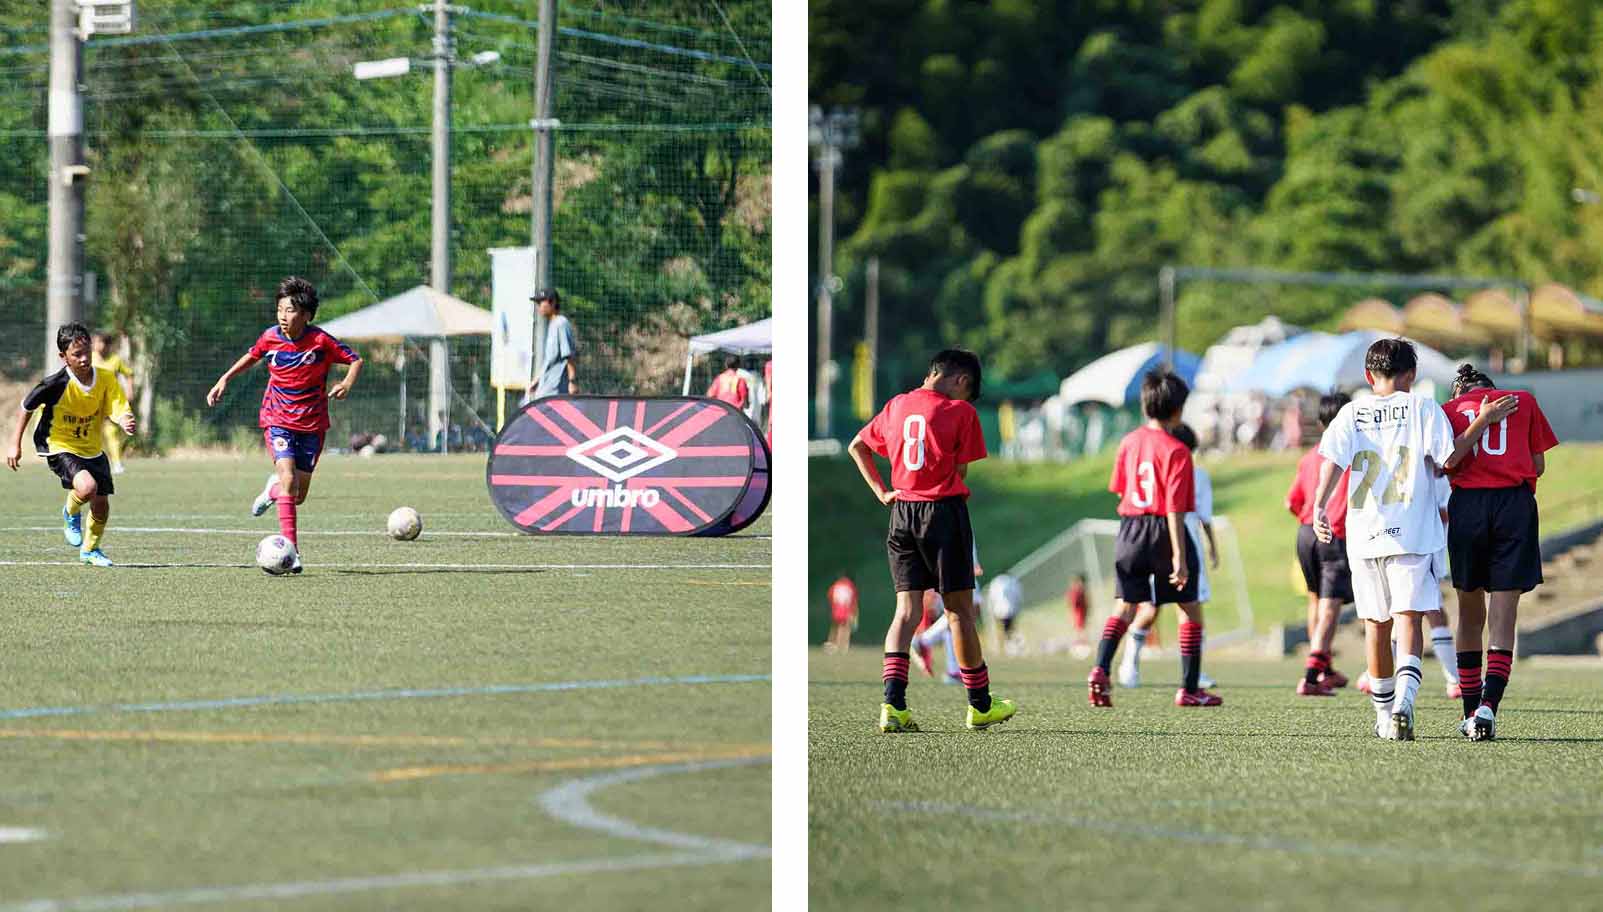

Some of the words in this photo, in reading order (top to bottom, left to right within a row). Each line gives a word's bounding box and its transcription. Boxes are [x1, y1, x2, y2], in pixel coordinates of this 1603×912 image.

[903, 414, 926, 471] 8
[571, 484, 660, 508] umbro
[1131, 461, 1155, 508] 3
